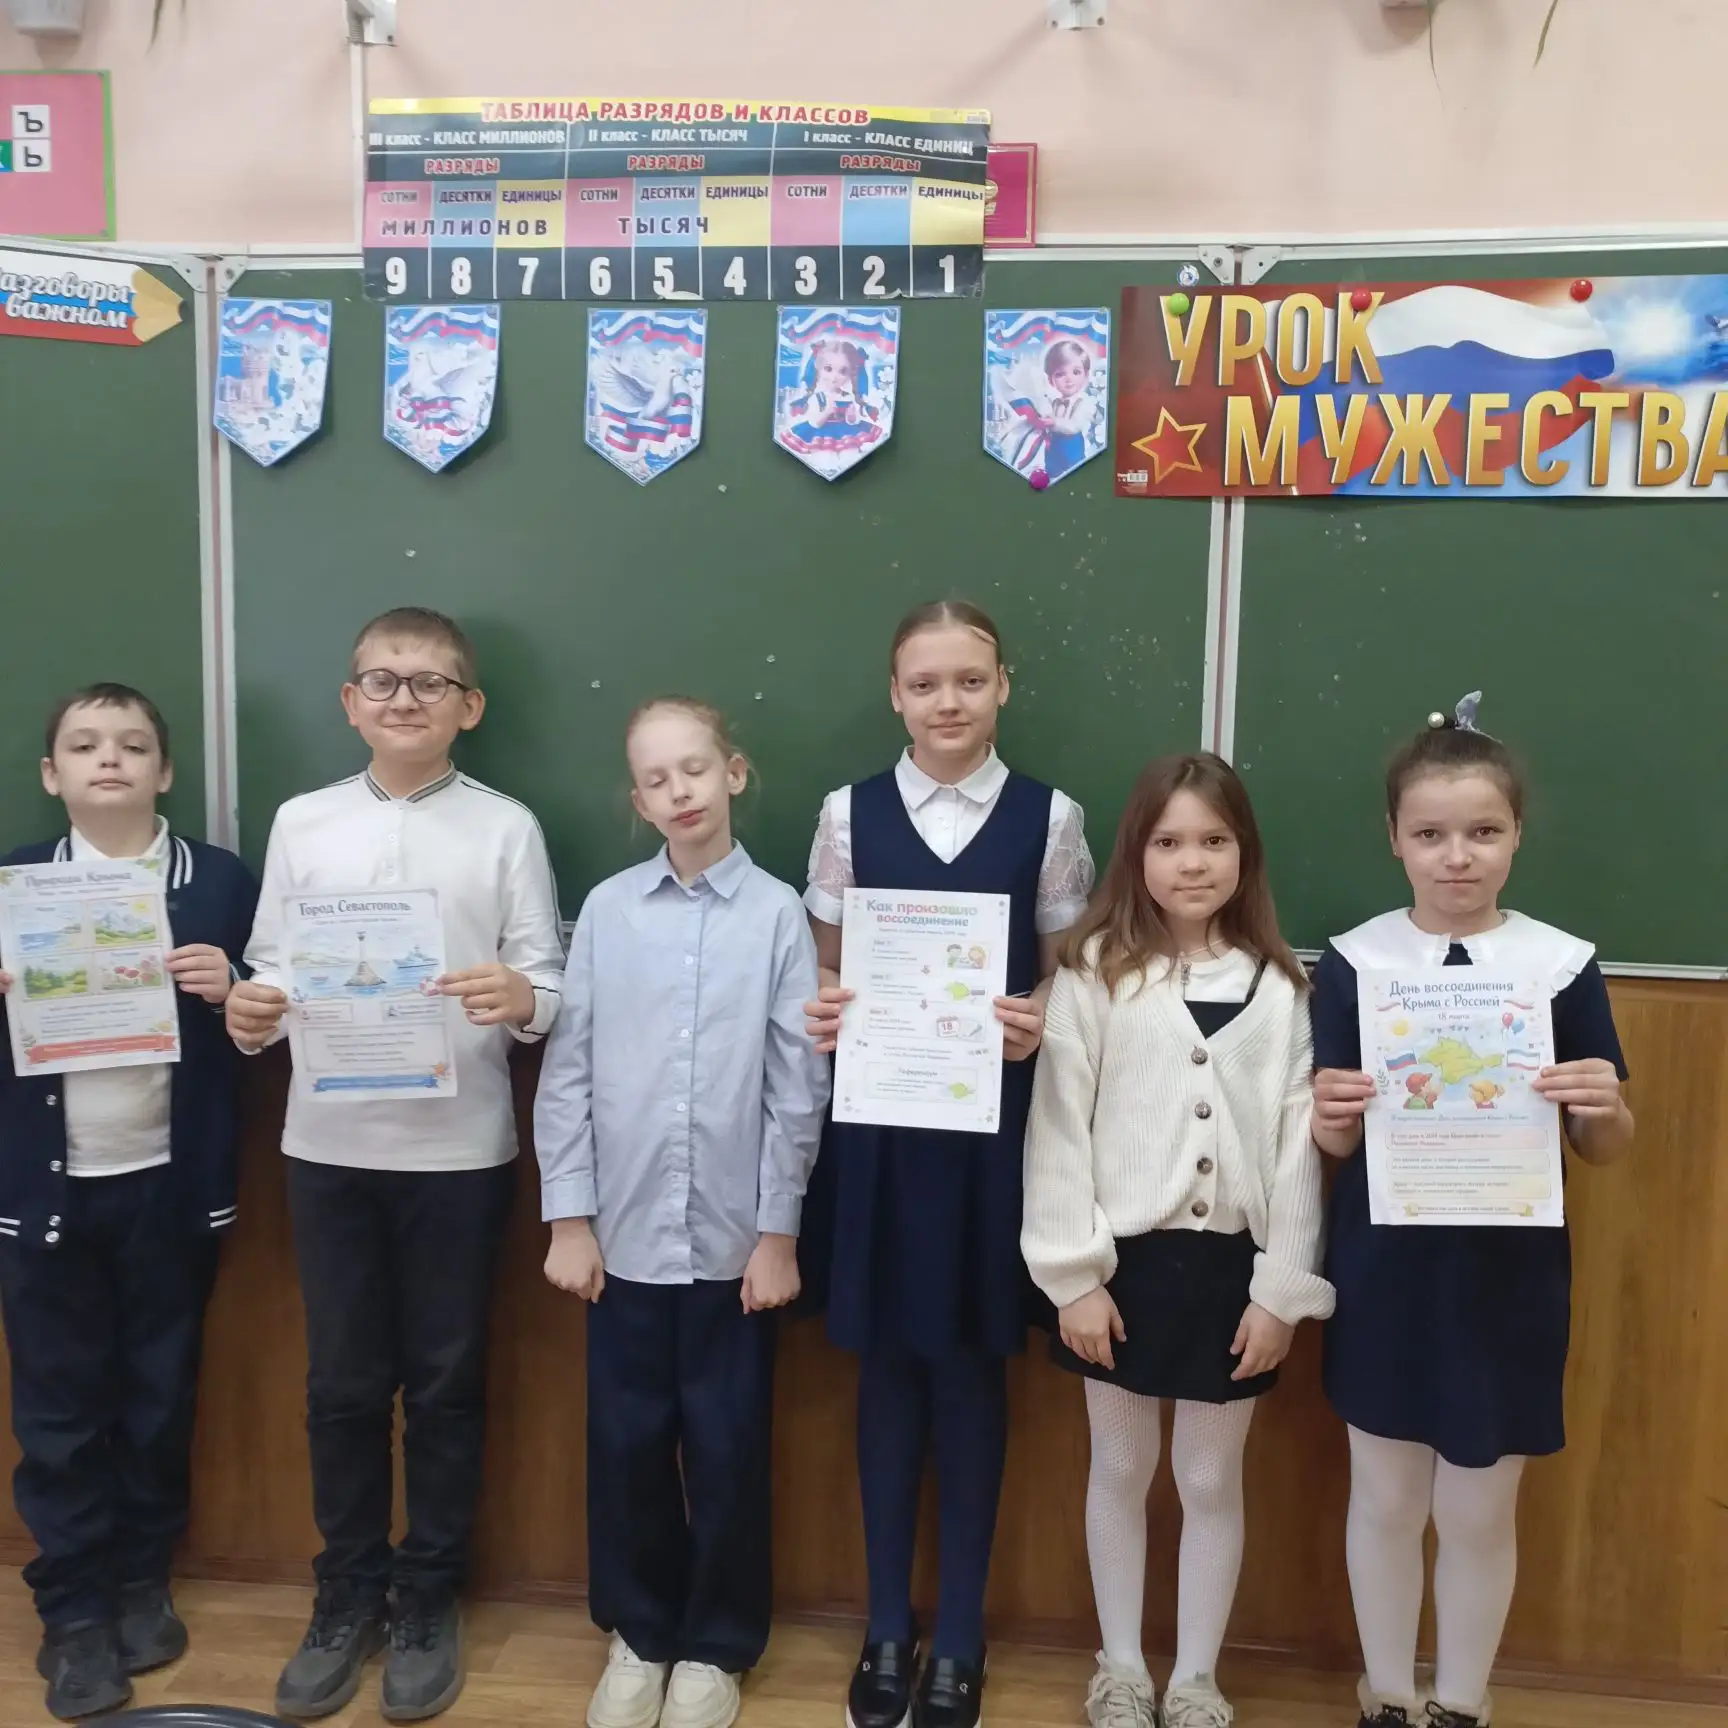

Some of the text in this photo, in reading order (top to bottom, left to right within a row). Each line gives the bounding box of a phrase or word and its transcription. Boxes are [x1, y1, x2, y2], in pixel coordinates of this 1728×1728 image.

[16, 111, 43, 132] Ъ
[482, 102, 869, 124] ТАБЛИЦА РАЗРЯДОВ И КЛАССОВ
[385, 134, 421, 146] класс
[433, 131, 477, 145] КЛАСС
[479, 130, 565, 144] МИЛЛИОНОВ
[601, 130, 638, 142] класс
[651, 128, 695, 142] КЛАСС
[699, 129, 748, 142] ТЫСЯЧ
[812, 132, 851, 145] класс
[864, 132, 911, 148] КЛАСС
[914, 136, 974, 156] ЕДИНИЦ
[24, 146, 43, 167] Ь
[628, 155, 704, 170] РАЗРЯДЫ
[840, 155, 921, 172] РАЗРЯДЫ
[425, 158, 499, 174] РАЗРЯДЫ
[380, 185, 984, 203] СОТНИ ДЕСЯТКИ ЕДИНИЦЫ СОТНИ ДЕСЯТКИ ЕДИНИЦЫ СОТНИ ДЕСЯТКИ ЕДИНИЦЫ
[382, 219, 548, 236] МИЛЛИОНОВ
[618, 217, 708, 234] ТЫСЯЧ
[385, 254, 955, 296] 9 8 7 6 5 4 3 2 1
[0, 266, 131, 307] азговоры
[5, 292, 128, 328] важном
[1159, 291, 1385, 387] УРОК
[1223, 389, 1728, 488] МУЖЕСТВА
[299, 899, 412, 916] Город Севастополь
[866, 899, 978, 916] Как произошло
[876, 914, 969, 927] воссоединение
[1389, 980, 1514, 997] День воссоединения
[1402, 995, 1500, 1012] Крыма с Россией
